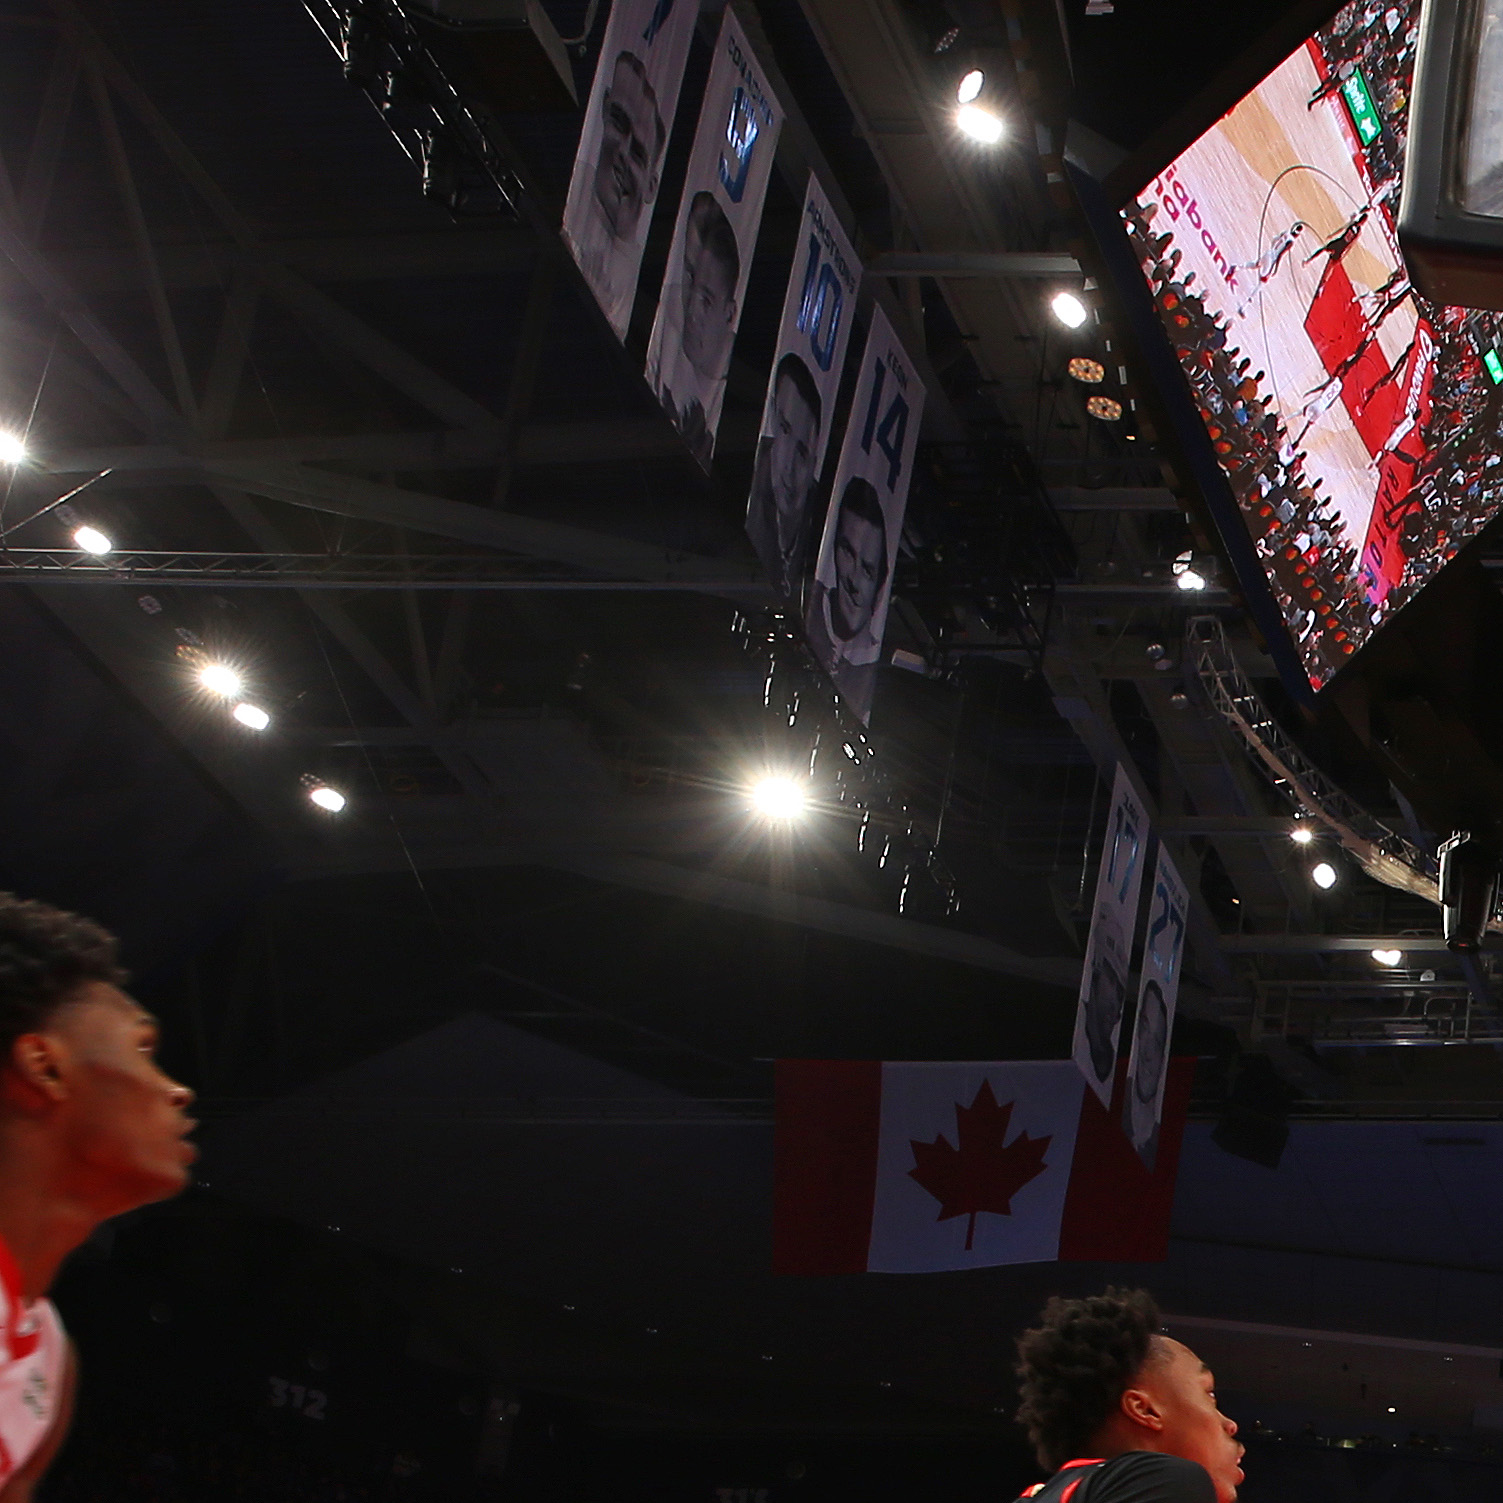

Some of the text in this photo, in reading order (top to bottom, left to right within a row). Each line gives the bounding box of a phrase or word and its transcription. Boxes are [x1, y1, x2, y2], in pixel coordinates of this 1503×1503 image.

[719, 86, 759, 203] 9
[796, 232, 842, 372] 10
[861, 356, 909, 494] 14
